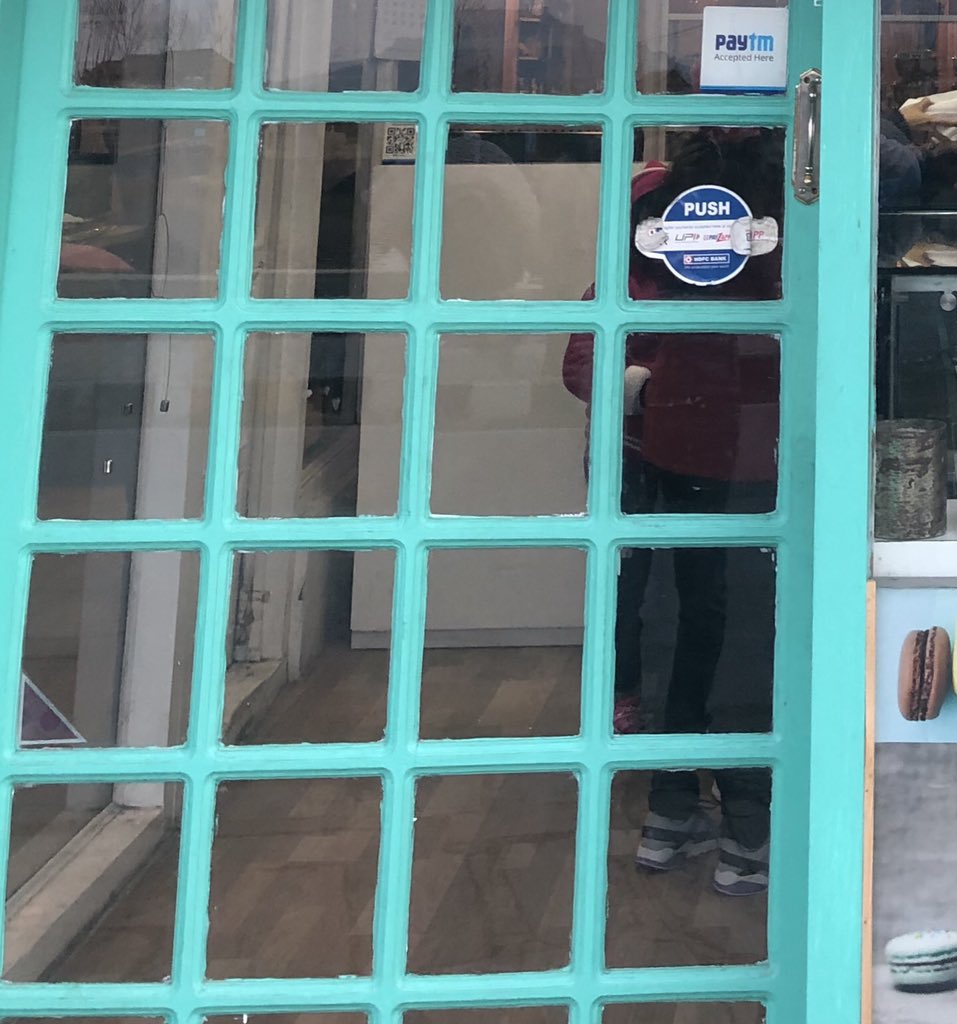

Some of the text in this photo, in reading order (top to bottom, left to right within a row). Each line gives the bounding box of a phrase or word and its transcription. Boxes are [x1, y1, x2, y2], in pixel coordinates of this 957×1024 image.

[714, 53, 775, 63] Accepted Here
[684, 201, 730, 217] PUSH
